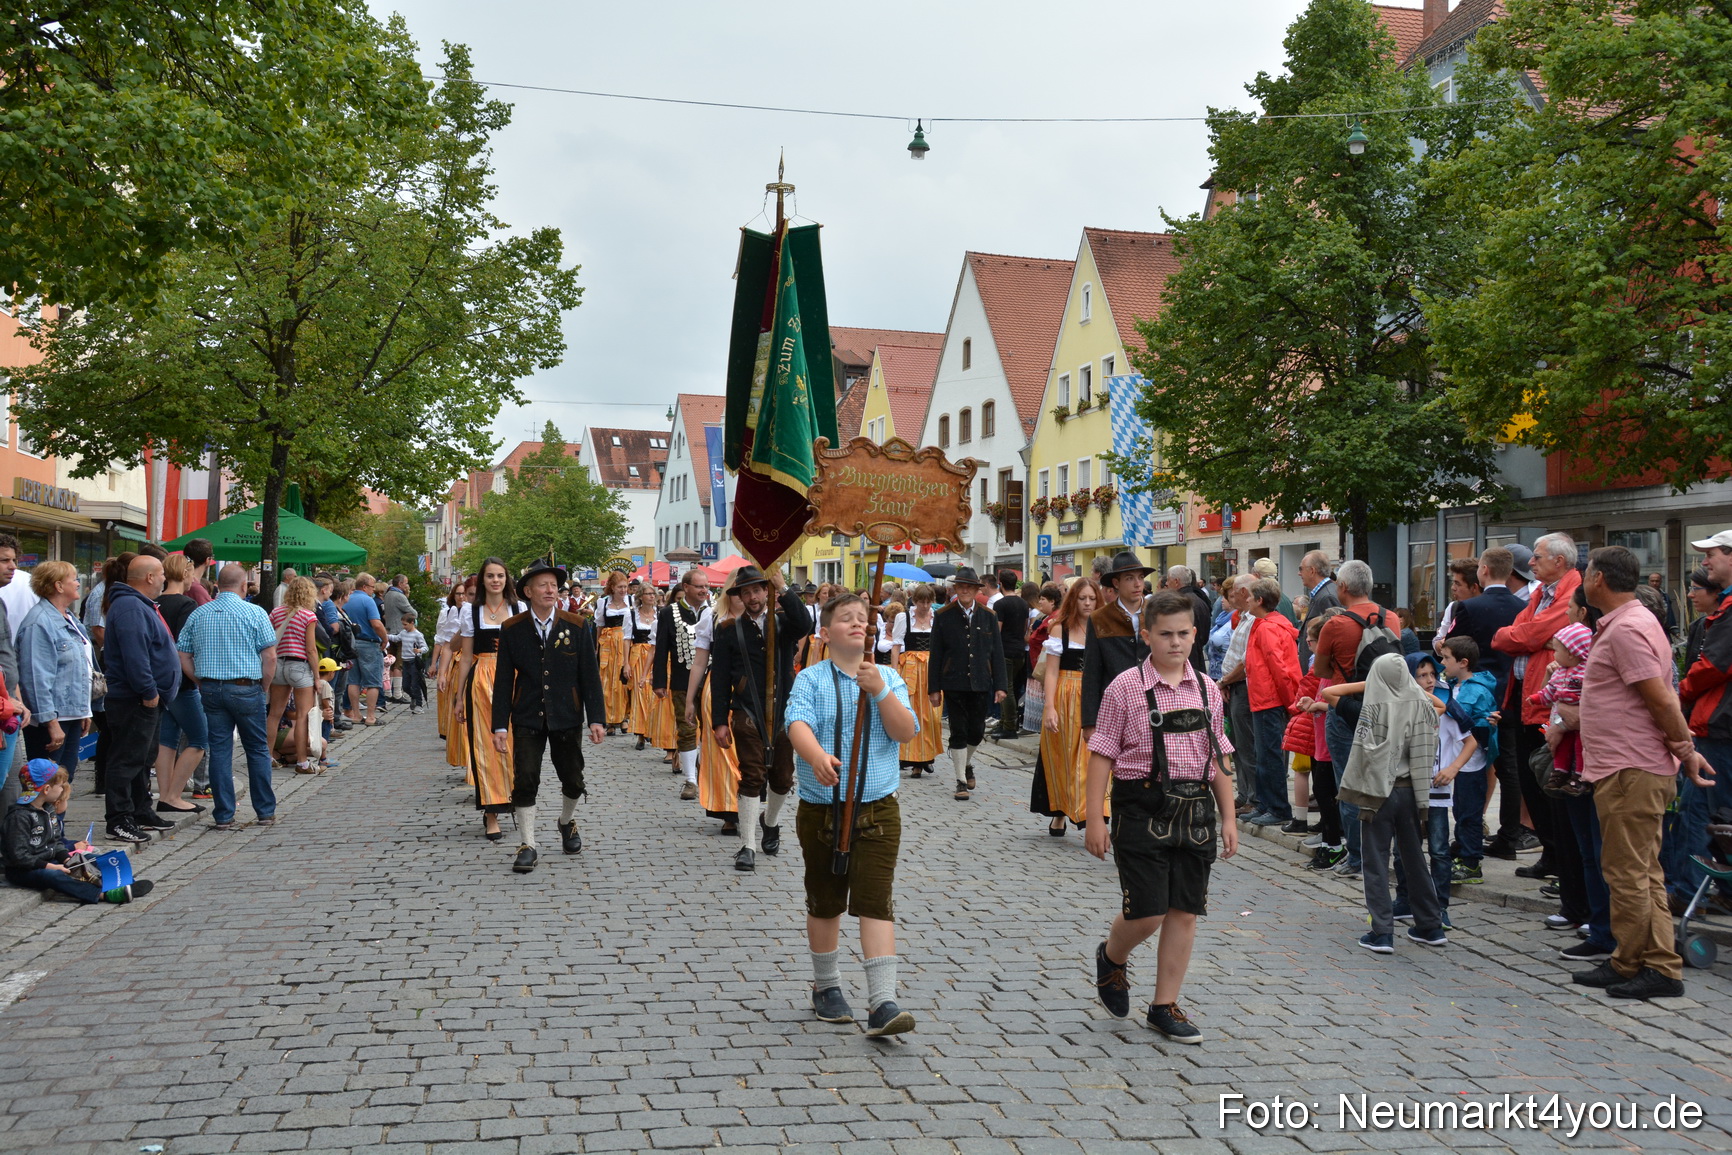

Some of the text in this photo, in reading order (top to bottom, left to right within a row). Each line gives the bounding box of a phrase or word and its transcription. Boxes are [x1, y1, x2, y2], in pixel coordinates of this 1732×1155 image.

[18, 477, 42, 504] LEDER
[836, 465, 949, 499] Burgschützen
[863, 495, 916, 520] Stauf
[1040, 537, 1049, 554] P
